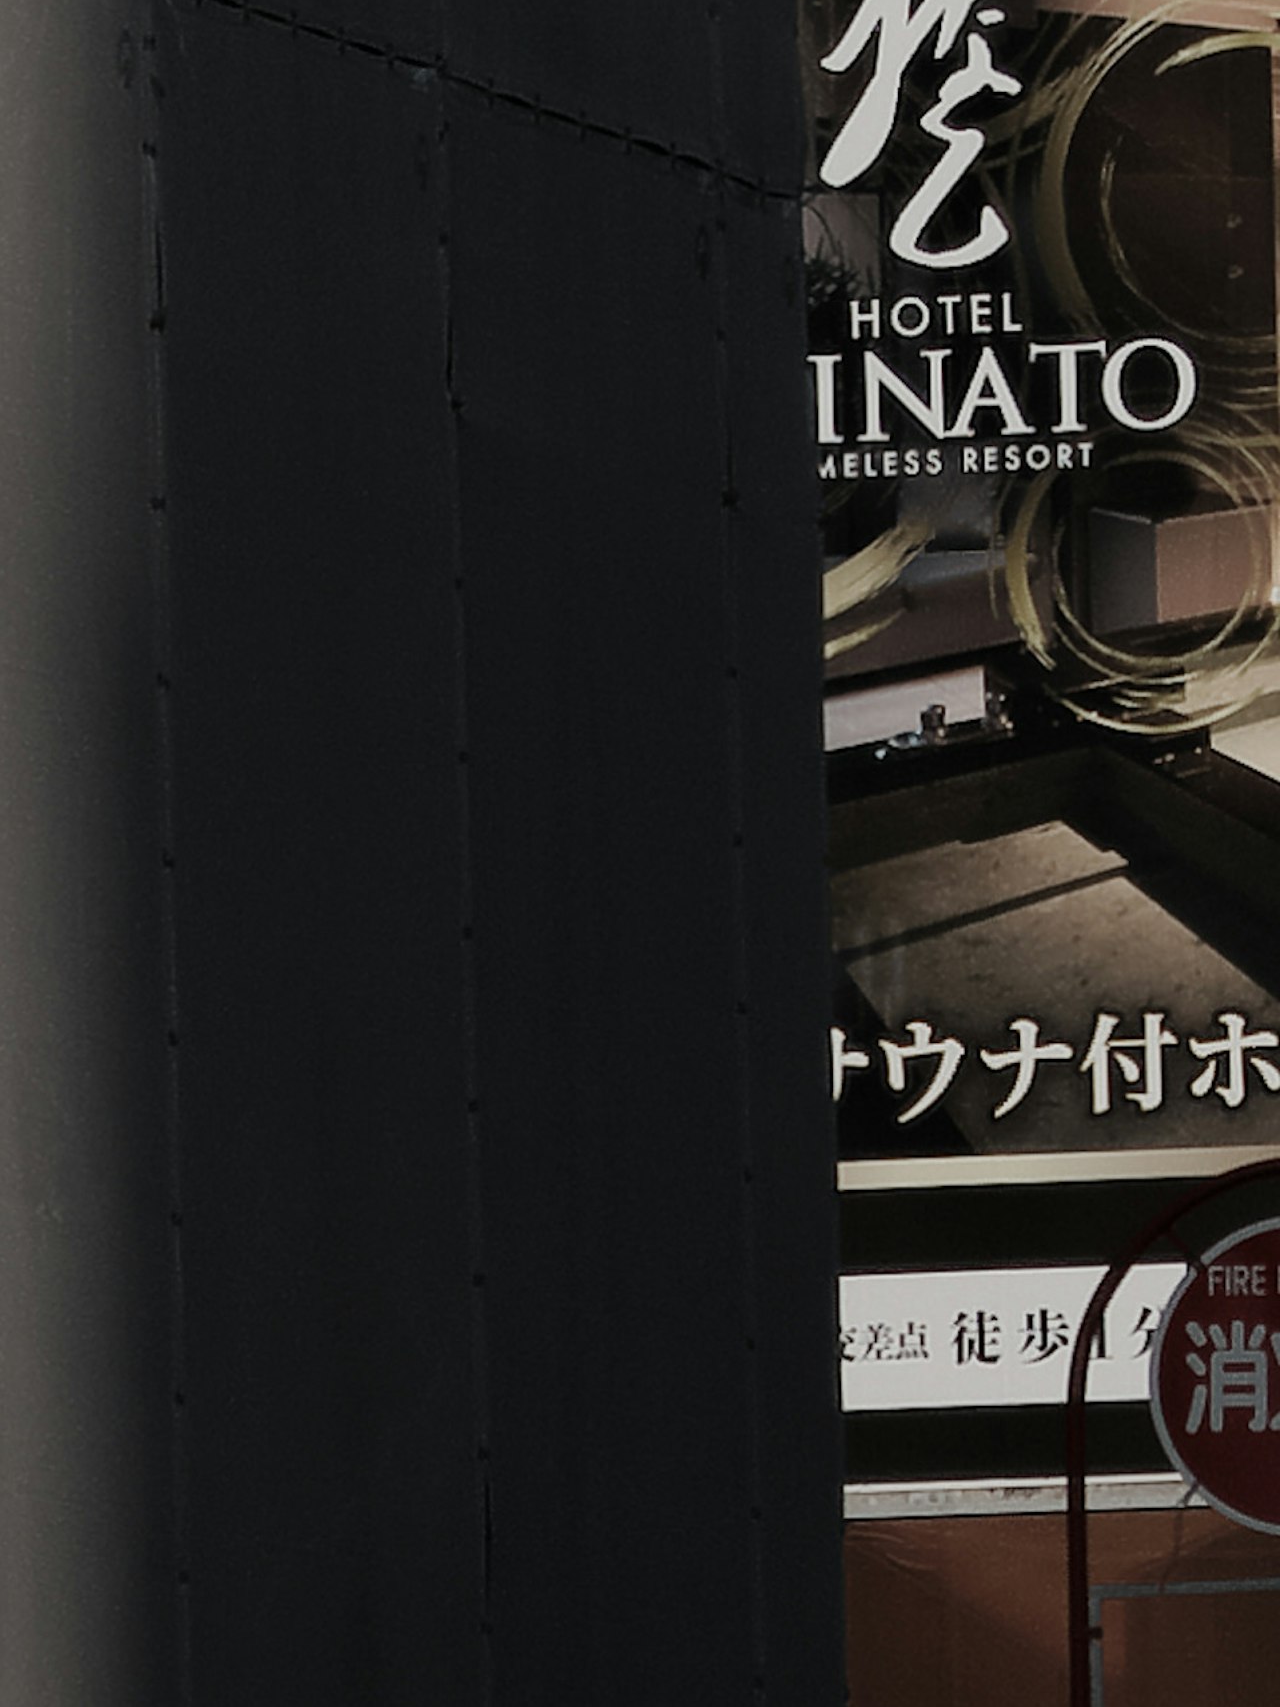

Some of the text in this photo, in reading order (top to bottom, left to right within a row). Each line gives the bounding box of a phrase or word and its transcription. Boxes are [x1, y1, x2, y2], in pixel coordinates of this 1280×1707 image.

[848, 291, 1024, 341] HOTEL
[961, 442, 1095, 474] RESORT
[1207, 1265, 1267, 1297] FIRE
[1185, 1320, 1280, 1434] 消
